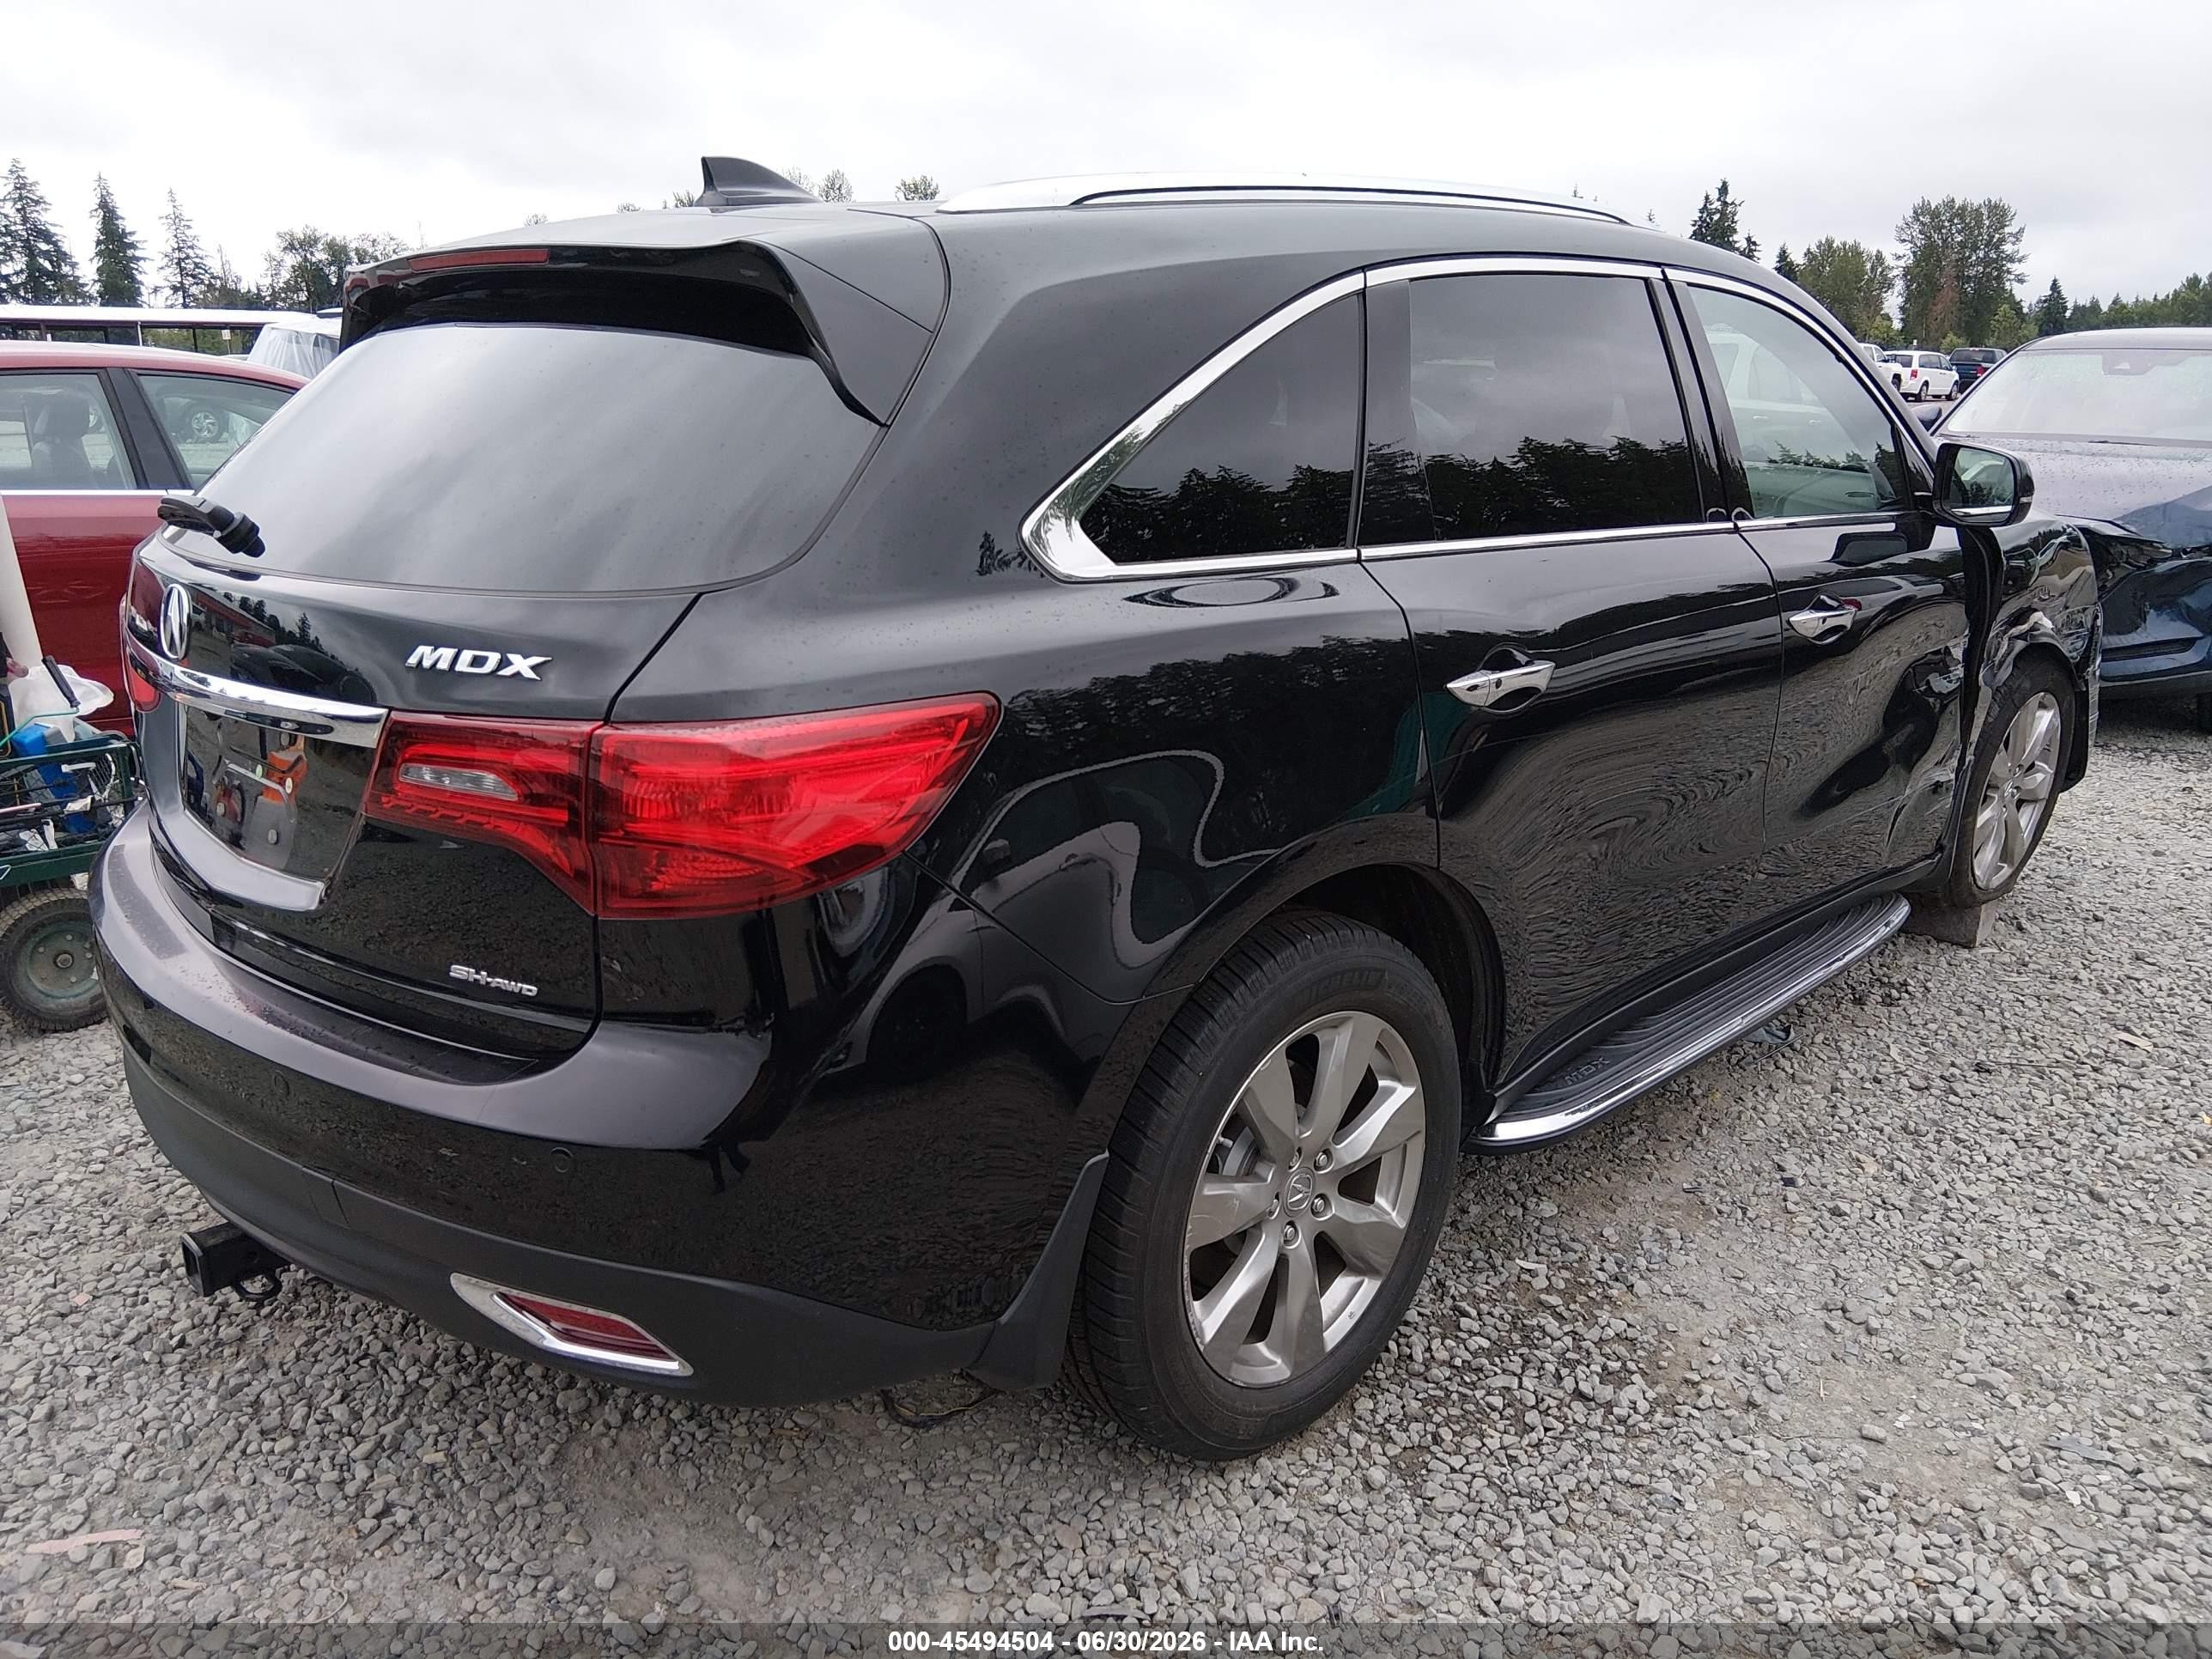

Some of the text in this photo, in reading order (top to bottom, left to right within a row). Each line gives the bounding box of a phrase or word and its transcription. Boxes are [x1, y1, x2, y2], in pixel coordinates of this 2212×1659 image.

[405, 645, 552, 680] MDX
[449, 964, 538, 996] SH-AWD
[1564, 1056, 1611, 1085] MDX
